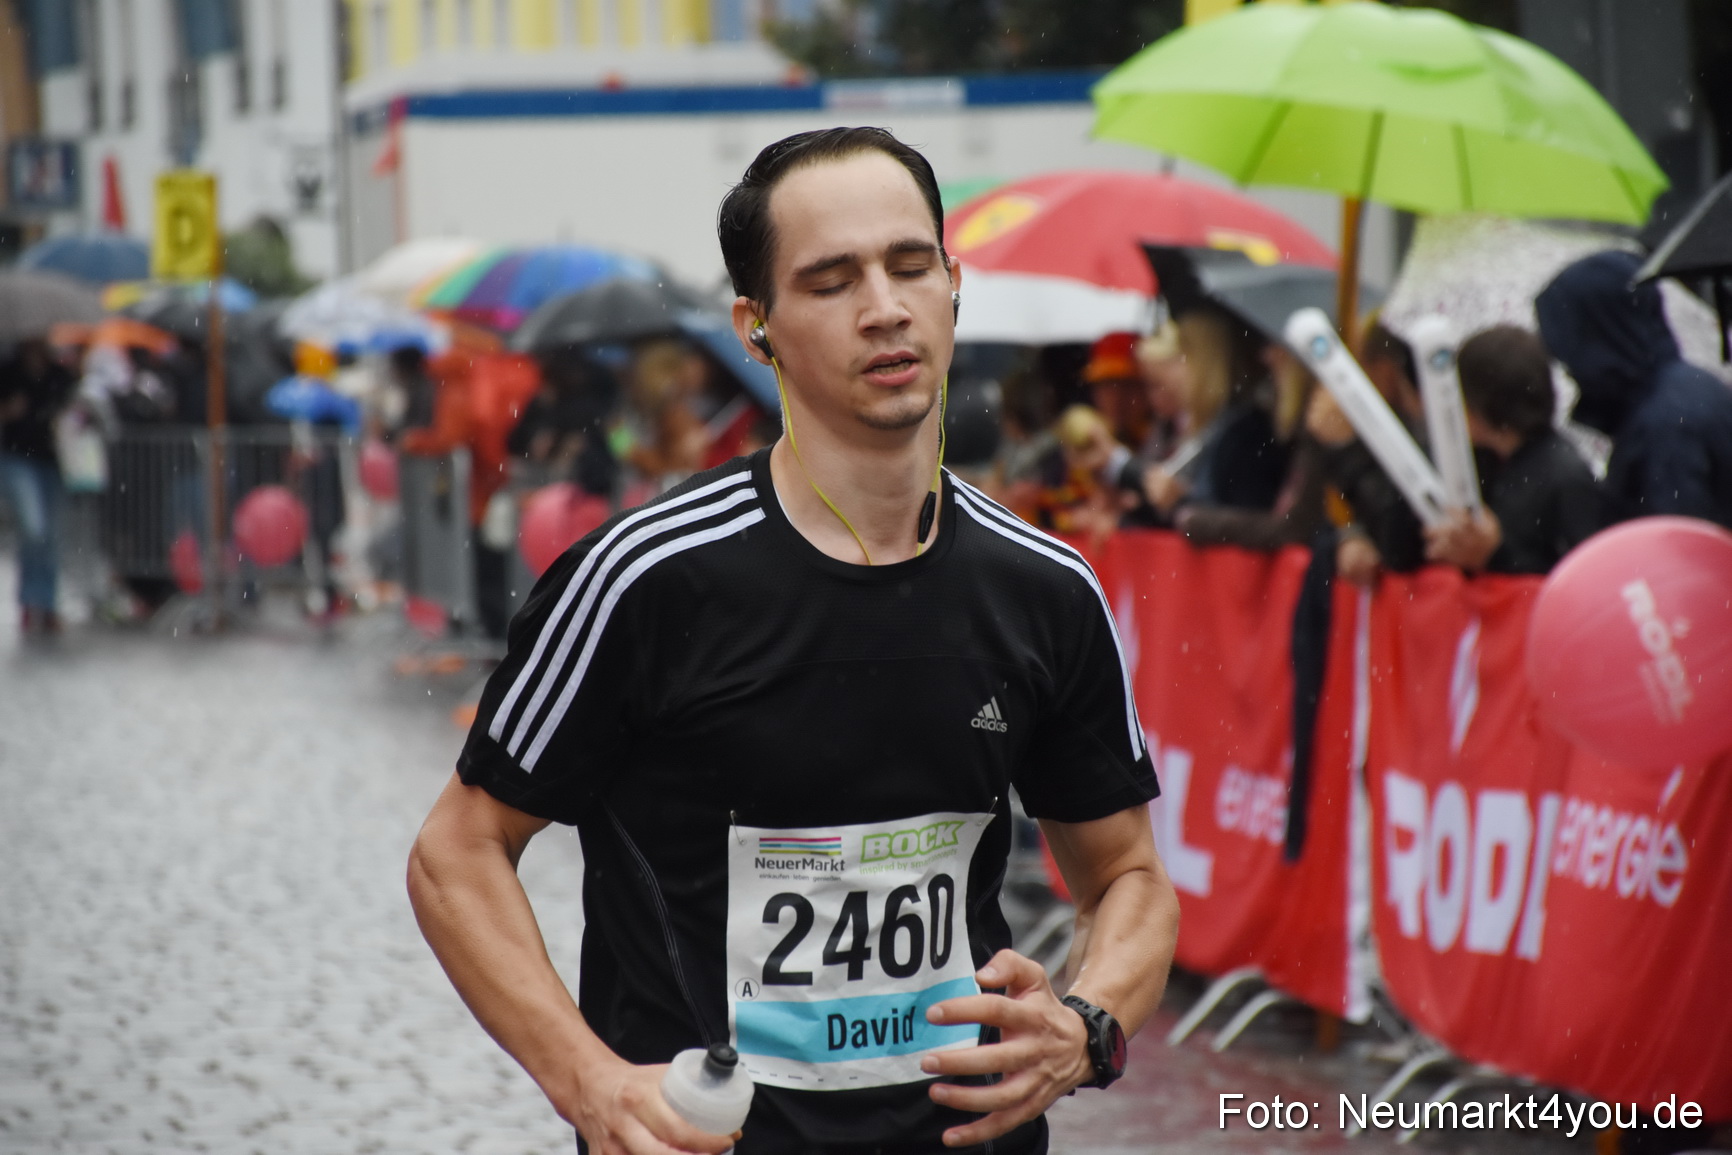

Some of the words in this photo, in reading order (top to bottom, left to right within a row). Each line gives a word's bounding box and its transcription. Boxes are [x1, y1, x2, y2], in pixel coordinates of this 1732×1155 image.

[860, 820, 966, 863] BOCK
[754, 857, 846, 872] NeuerMarkt
[860, 862, 895, 876] inspired
[897, 861, 908, 872] by
[761, 873, 955, 986] 2460
[742, 981, 753, 997] A
[827, 1005, 916, 1052] David
